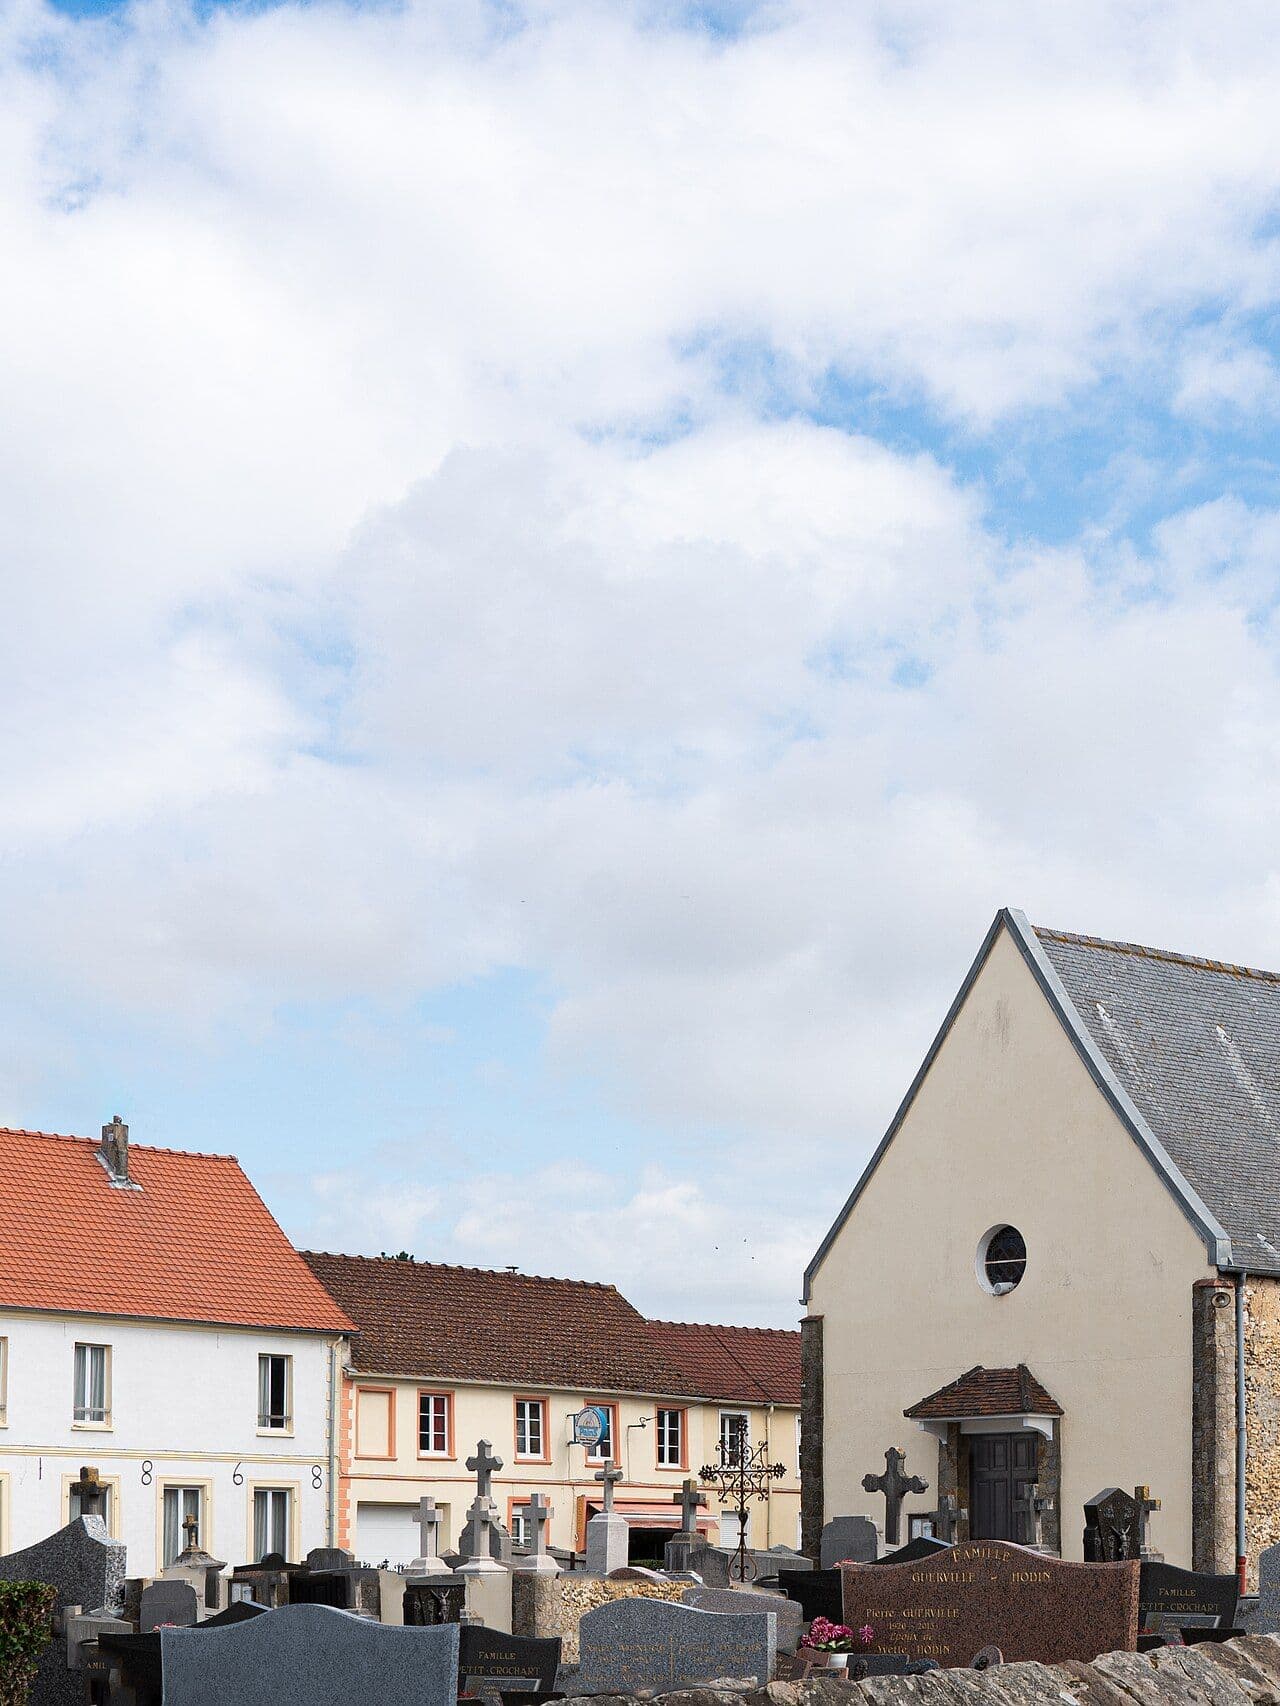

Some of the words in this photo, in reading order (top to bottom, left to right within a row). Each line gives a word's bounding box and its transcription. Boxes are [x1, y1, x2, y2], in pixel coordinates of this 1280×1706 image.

[952, 1548, 1012, 1563] FAMILLE
[912, 1572, 976, 1583] GUERVILLE
[1011, 1571, 1051, 1583] HODIN
[1159, 1588, 1197, 1597] FAMILLE
[866, 1608, 895, 1619] Pierre
[902, 1608, 960, 1619] GUERVILLE
[917, 1645, 951, 1655] HODIN
[478, 1651, 517, 1660] FAMILLE
